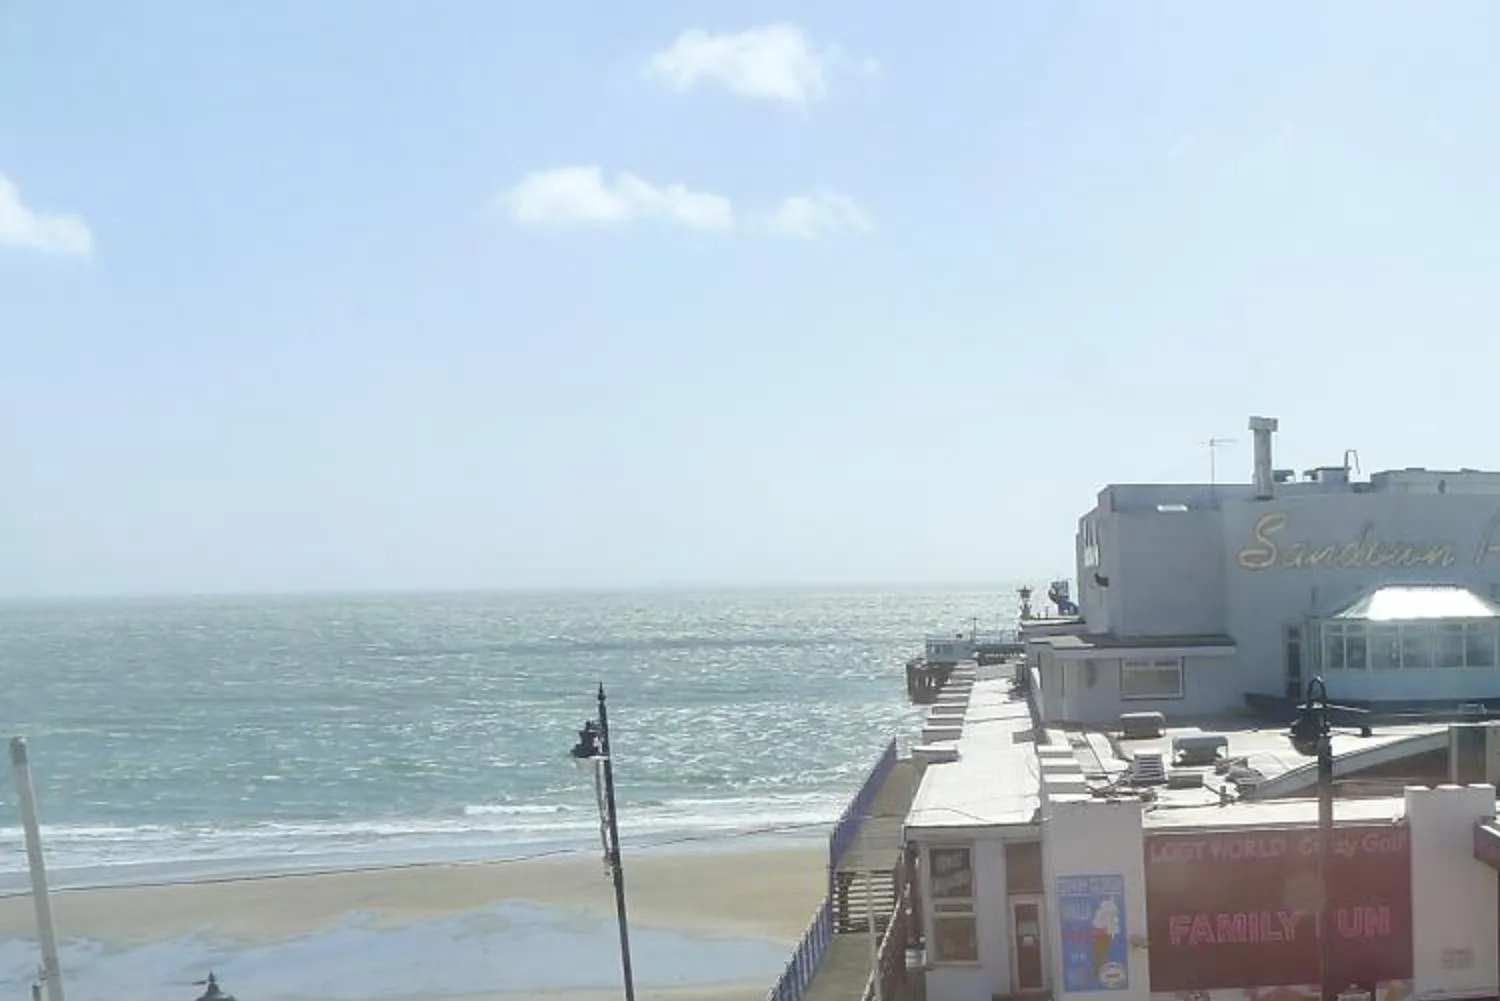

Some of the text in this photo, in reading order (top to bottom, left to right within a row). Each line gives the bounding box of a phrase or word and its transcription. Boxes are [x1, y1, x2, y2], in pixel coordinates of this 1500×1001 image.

[1238, 510, 1456, 571] Sandown
[1150, 840, 1205, 862] LOST
[1208, 836, 1286, 861] WORLD
[1168, 908, 1300, 946] FAMILY
